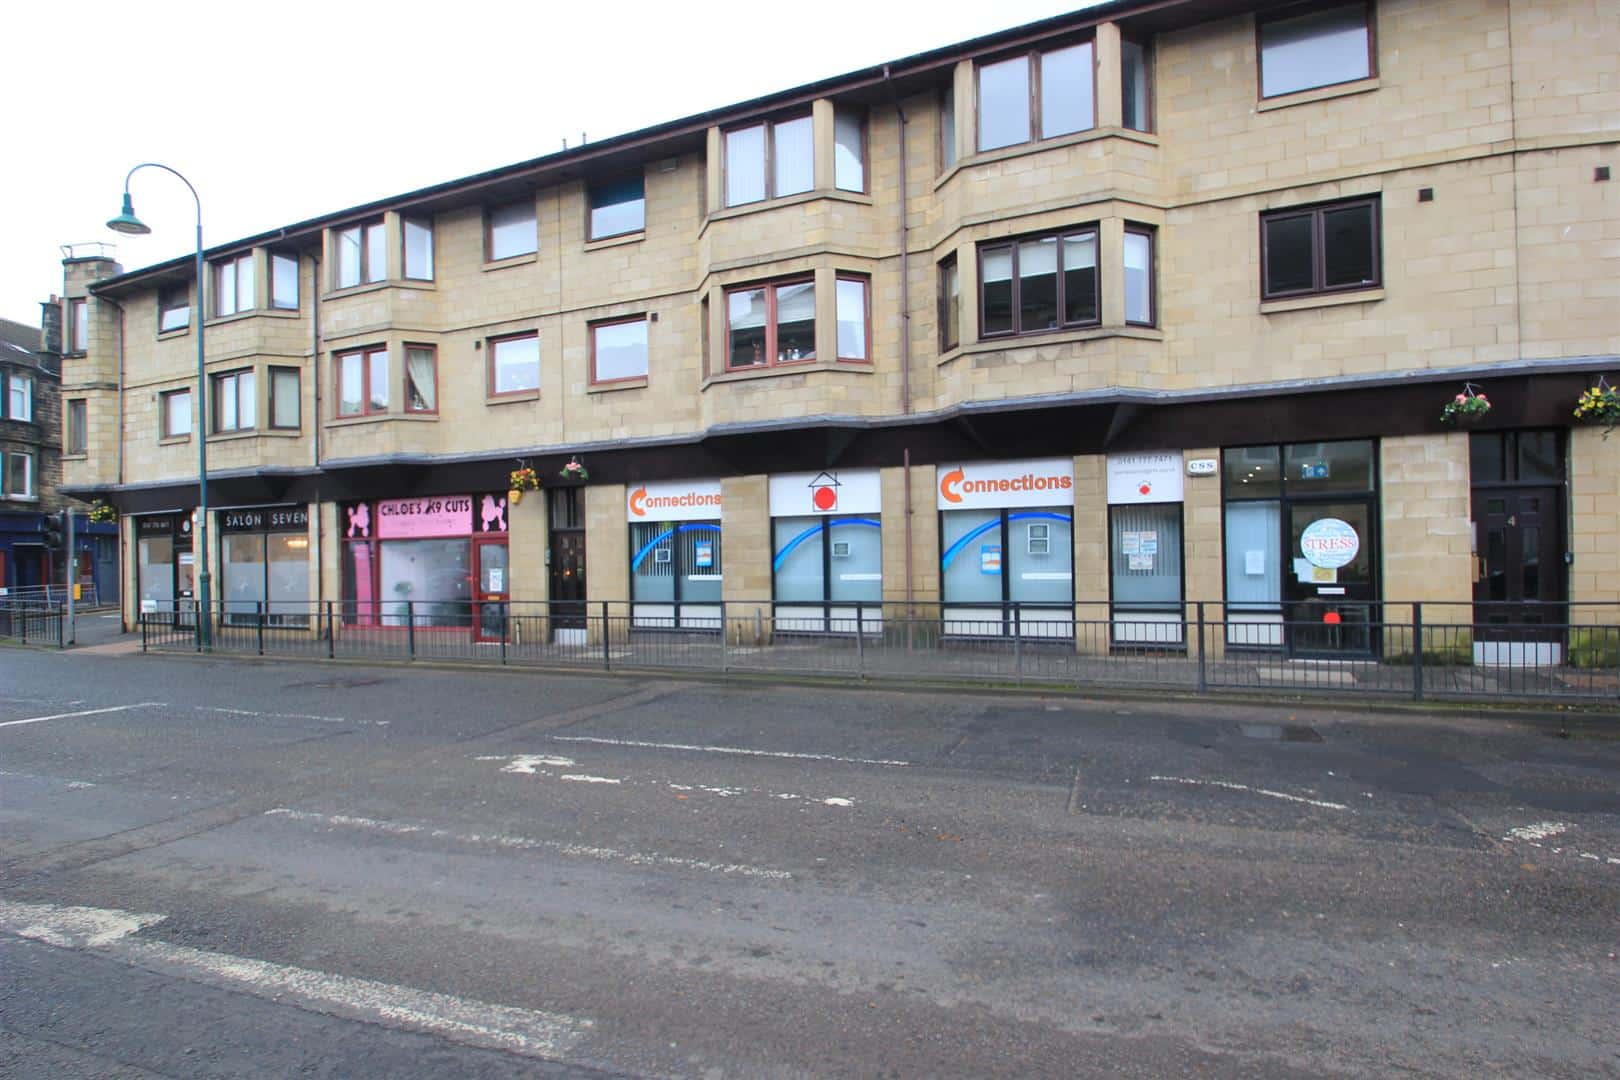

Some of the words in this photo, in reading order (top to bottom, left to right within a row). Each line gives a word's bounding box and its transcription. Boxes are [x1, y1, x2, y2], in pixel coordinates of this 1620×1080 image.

[1190, 462, 1215, 471] CSS
[940, 465, 1073, 503] Connections
[381, 502, 422, 516] CHLOE'S
[445, 499, 470, 512] CUTS
[629, 484, 722, 517] Connections
[226, 514, 262, 527] SALON
[272, 511, 308, 525] SEVEN
[1304, 536, 1355, 550] STRESS
